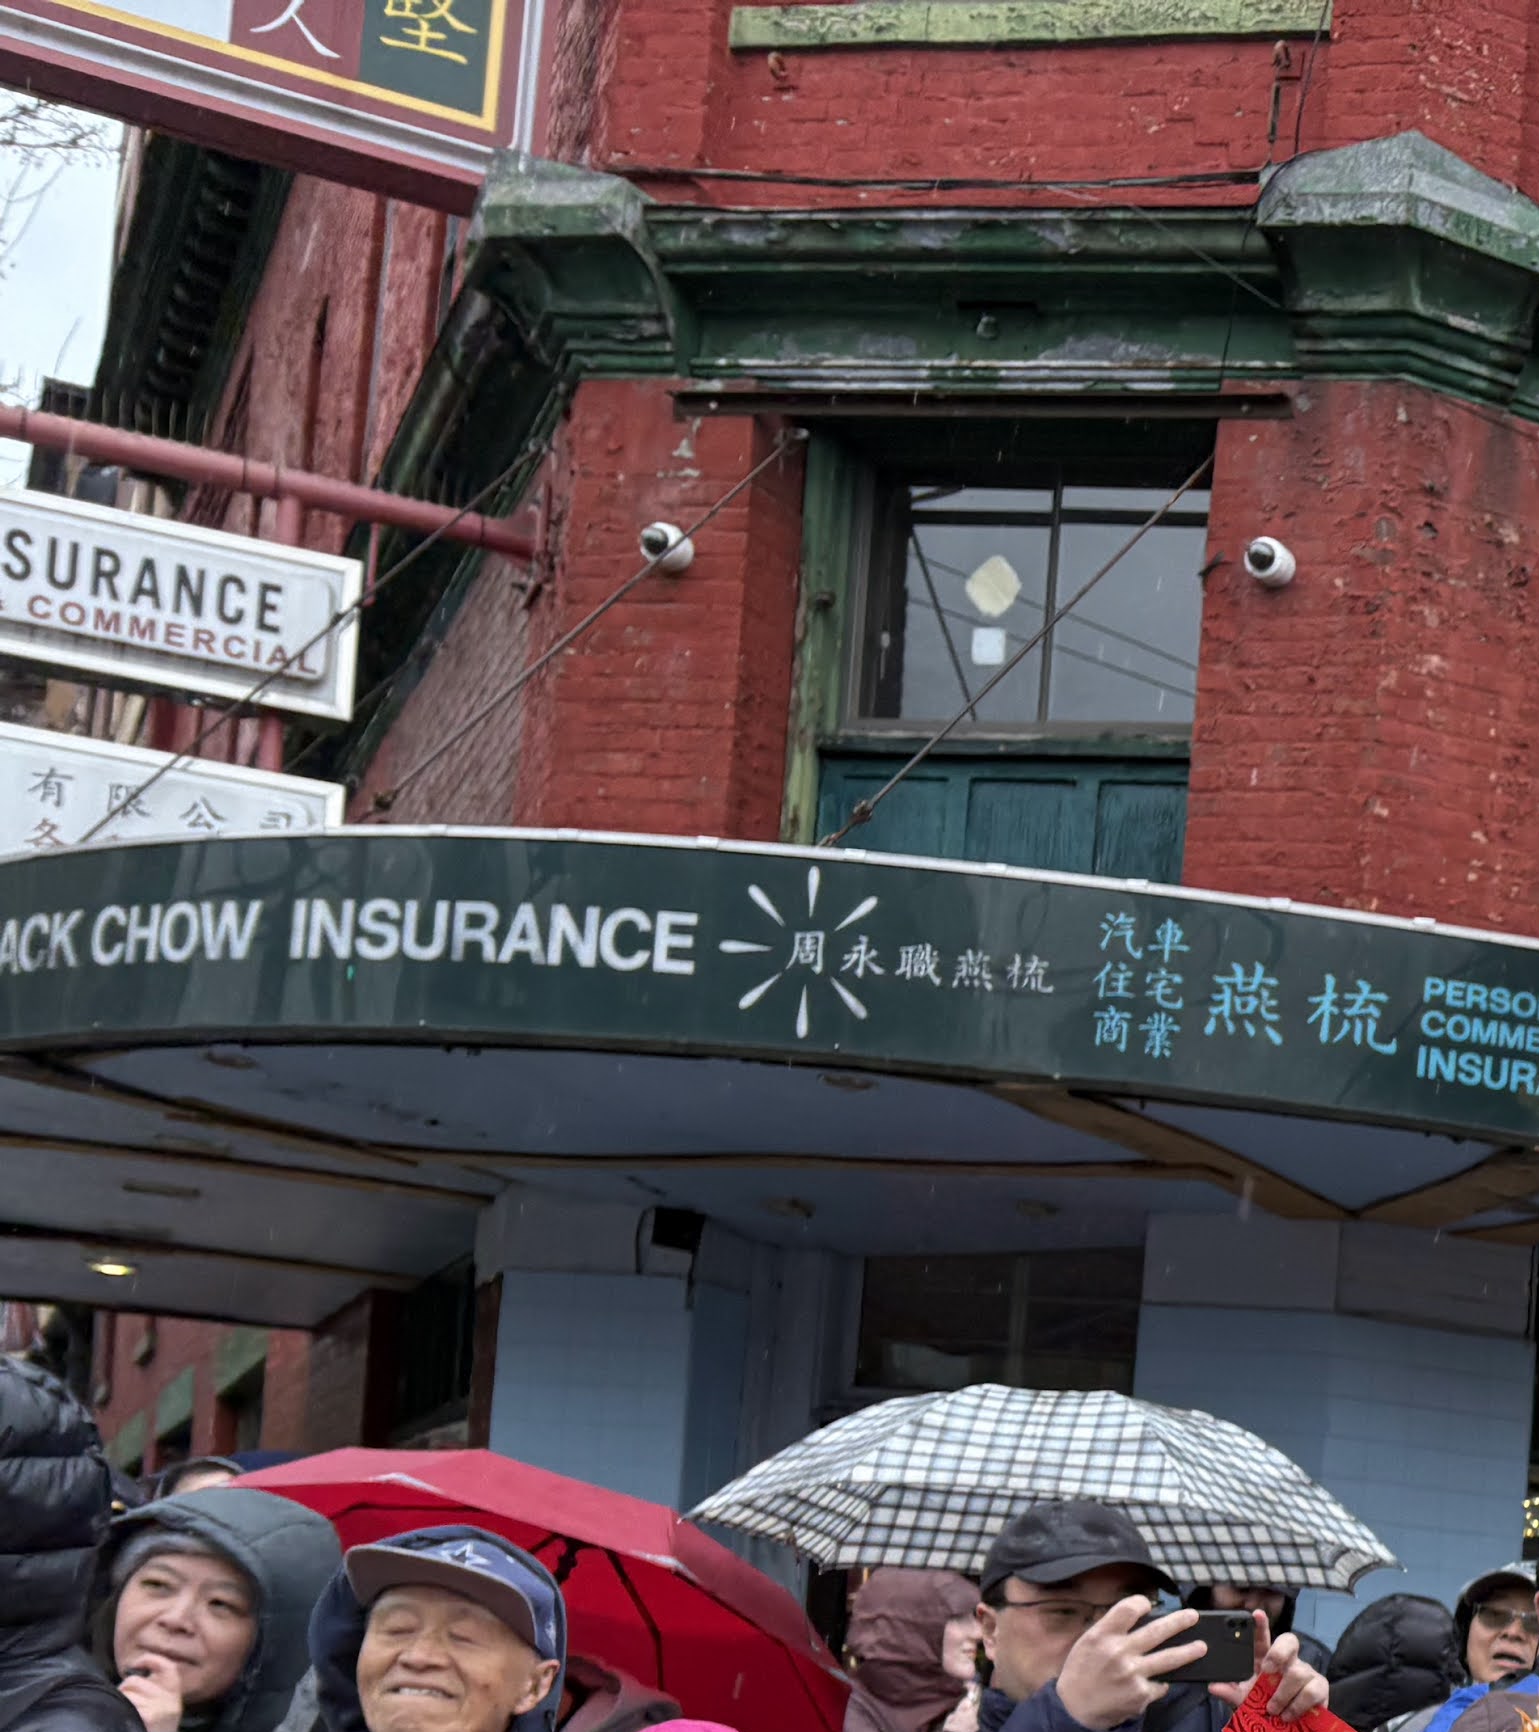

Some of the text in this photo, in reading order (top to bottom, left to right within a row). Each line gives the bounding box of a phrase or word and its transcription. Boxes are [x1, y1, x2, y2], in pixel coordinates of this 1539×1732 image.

[2, 527, 283, 634] SURANCE
[27, 594, 318, 675] COMMERCIAL
[91, 899, 262, 966] CHOW
[290, 898, 699, 976] INSURANCE
[1099, 911, 1191, 963] 汽車
[1093, 961, 1184, 1010] 住宅
[1204, 960, 1398, 1055] 燕梳
